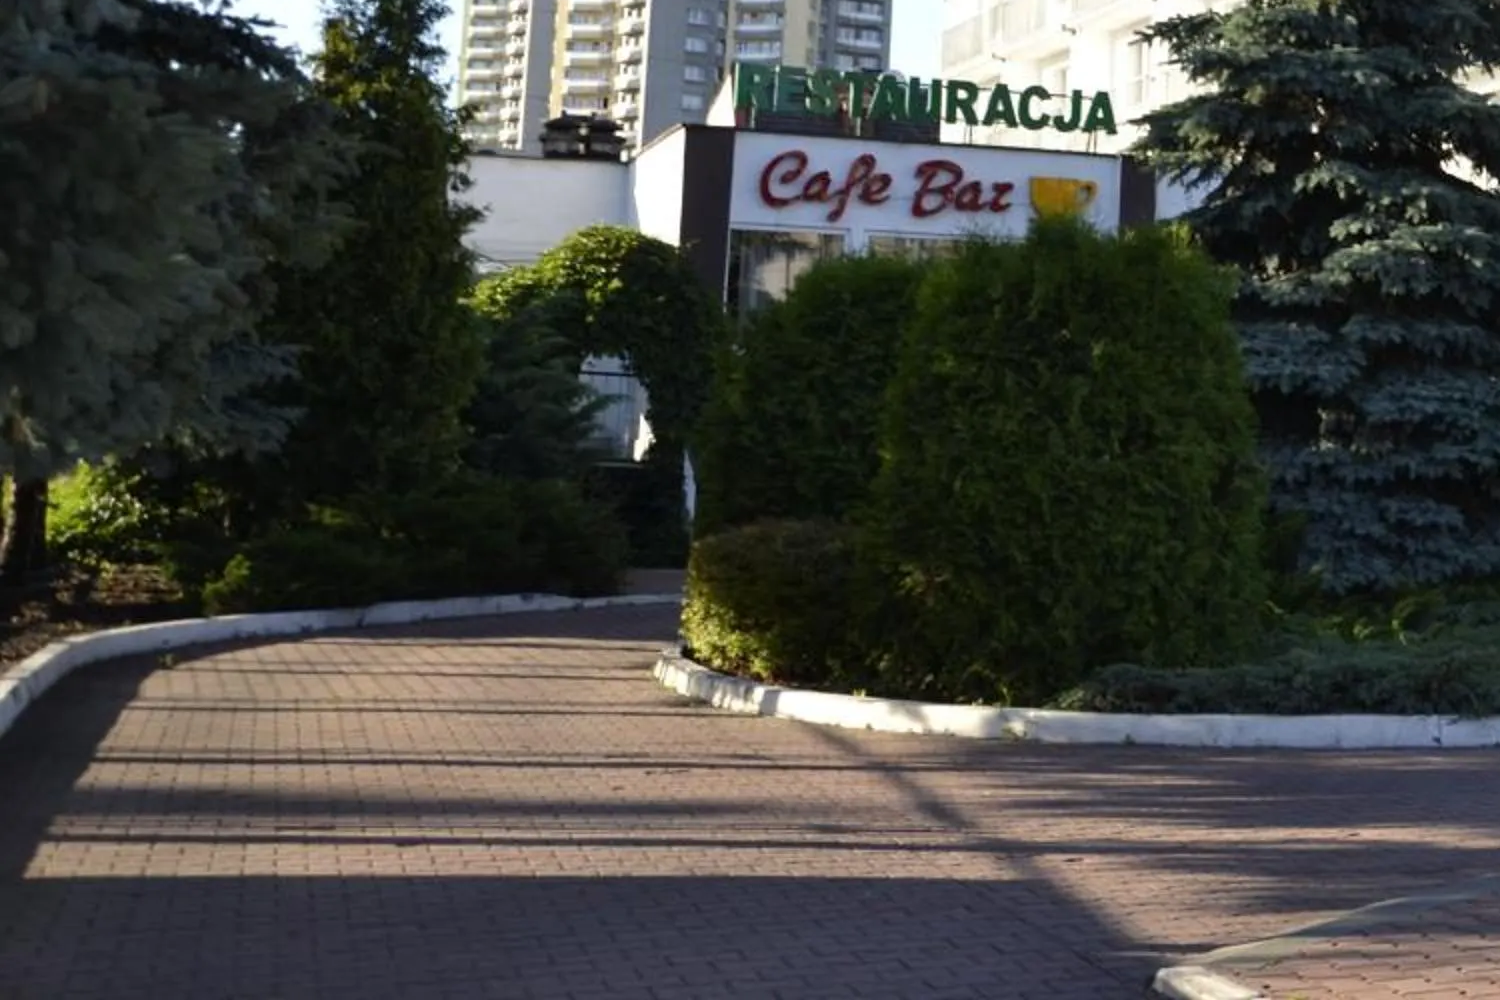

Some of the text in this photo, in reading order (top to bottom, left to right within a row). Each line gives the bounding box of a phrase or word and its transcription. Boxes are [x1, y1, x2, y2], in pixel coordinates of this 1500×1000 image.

[733, 61, 1117, 134] RESTAURACJA
[759, 150, 1015, 222] Cafe Bar
